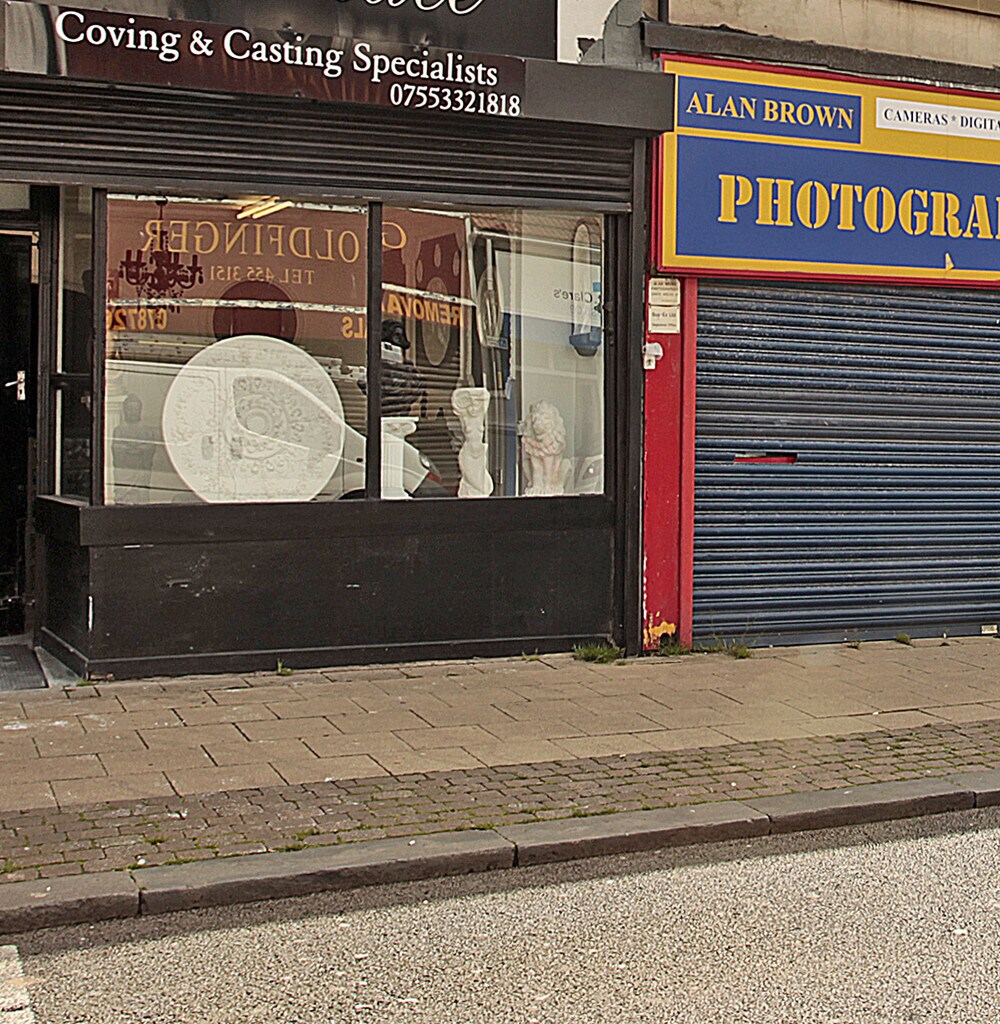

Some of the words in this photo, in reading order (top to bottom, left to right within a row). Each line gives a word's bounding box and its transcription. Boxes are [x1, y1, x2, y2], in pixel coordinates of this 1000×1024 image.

[55, 11, 181, 61] Coving
[190, 31, 214, 57] &
[223, 29, 343, 77] Casting
[353, 43, 499, 87] Specialists
[390, 84, 522, 117] 07553321818
[686, 91, 757, 120] ALAN
[762, 99, 854, 131] BROWN
[884, 107, 949, 126] CAMERAS
